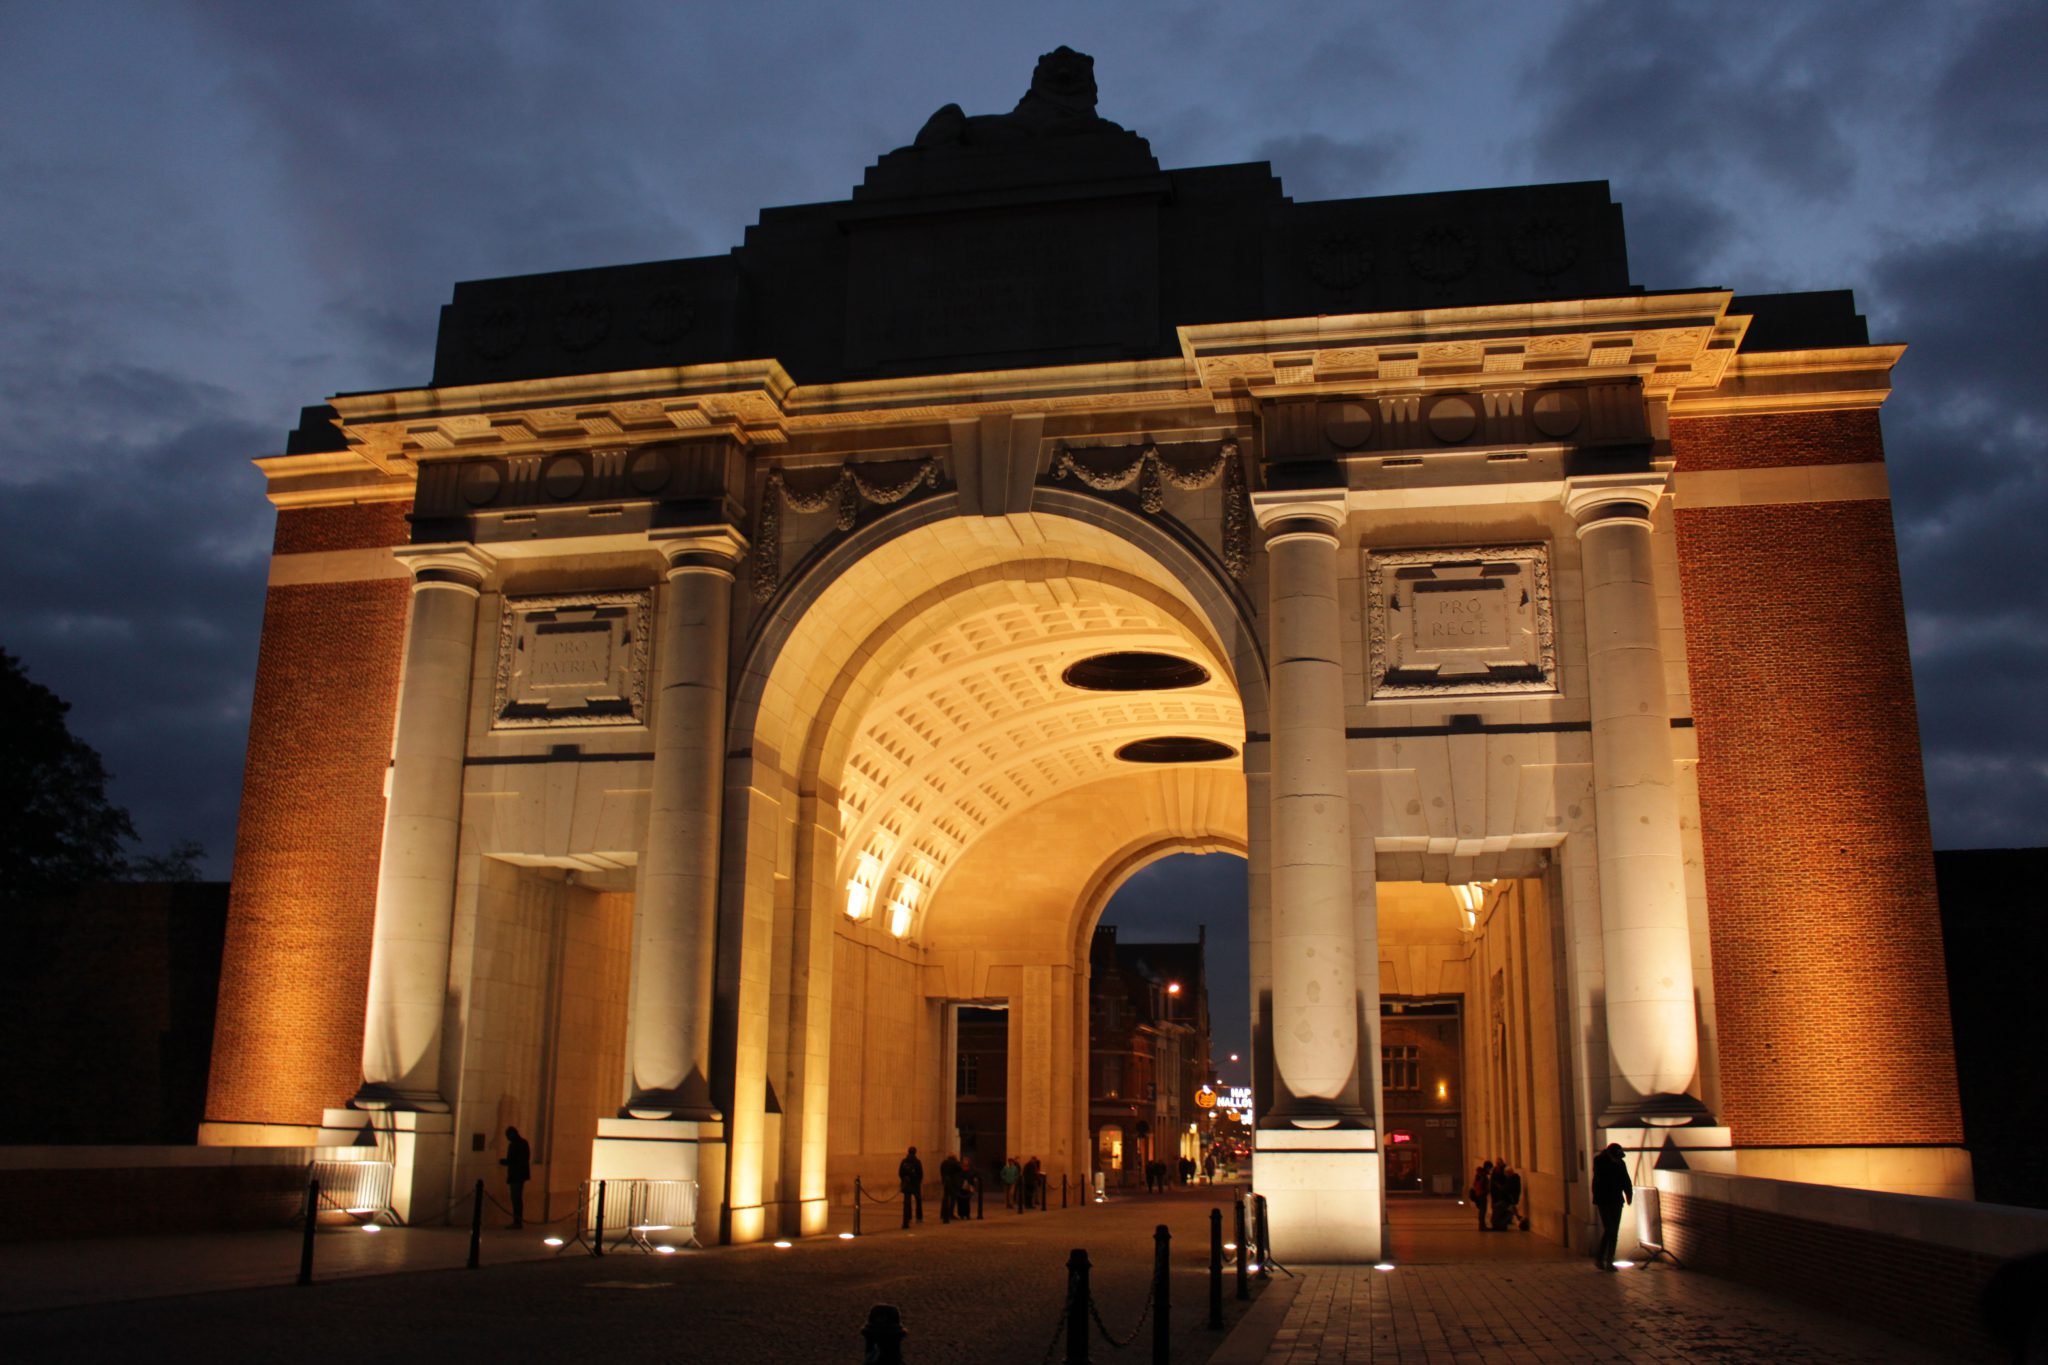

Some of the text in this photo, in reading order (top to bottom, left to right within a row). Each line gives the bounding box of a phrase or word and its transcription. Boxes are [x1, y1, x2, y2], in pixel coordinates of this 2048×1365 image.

[1439, 598, 1482, 615] PRO
[1432, 620, 1490, 637] REGE
[553, 639, 589, 655] PRO
[539, 658, 600, 675] PATRIA
